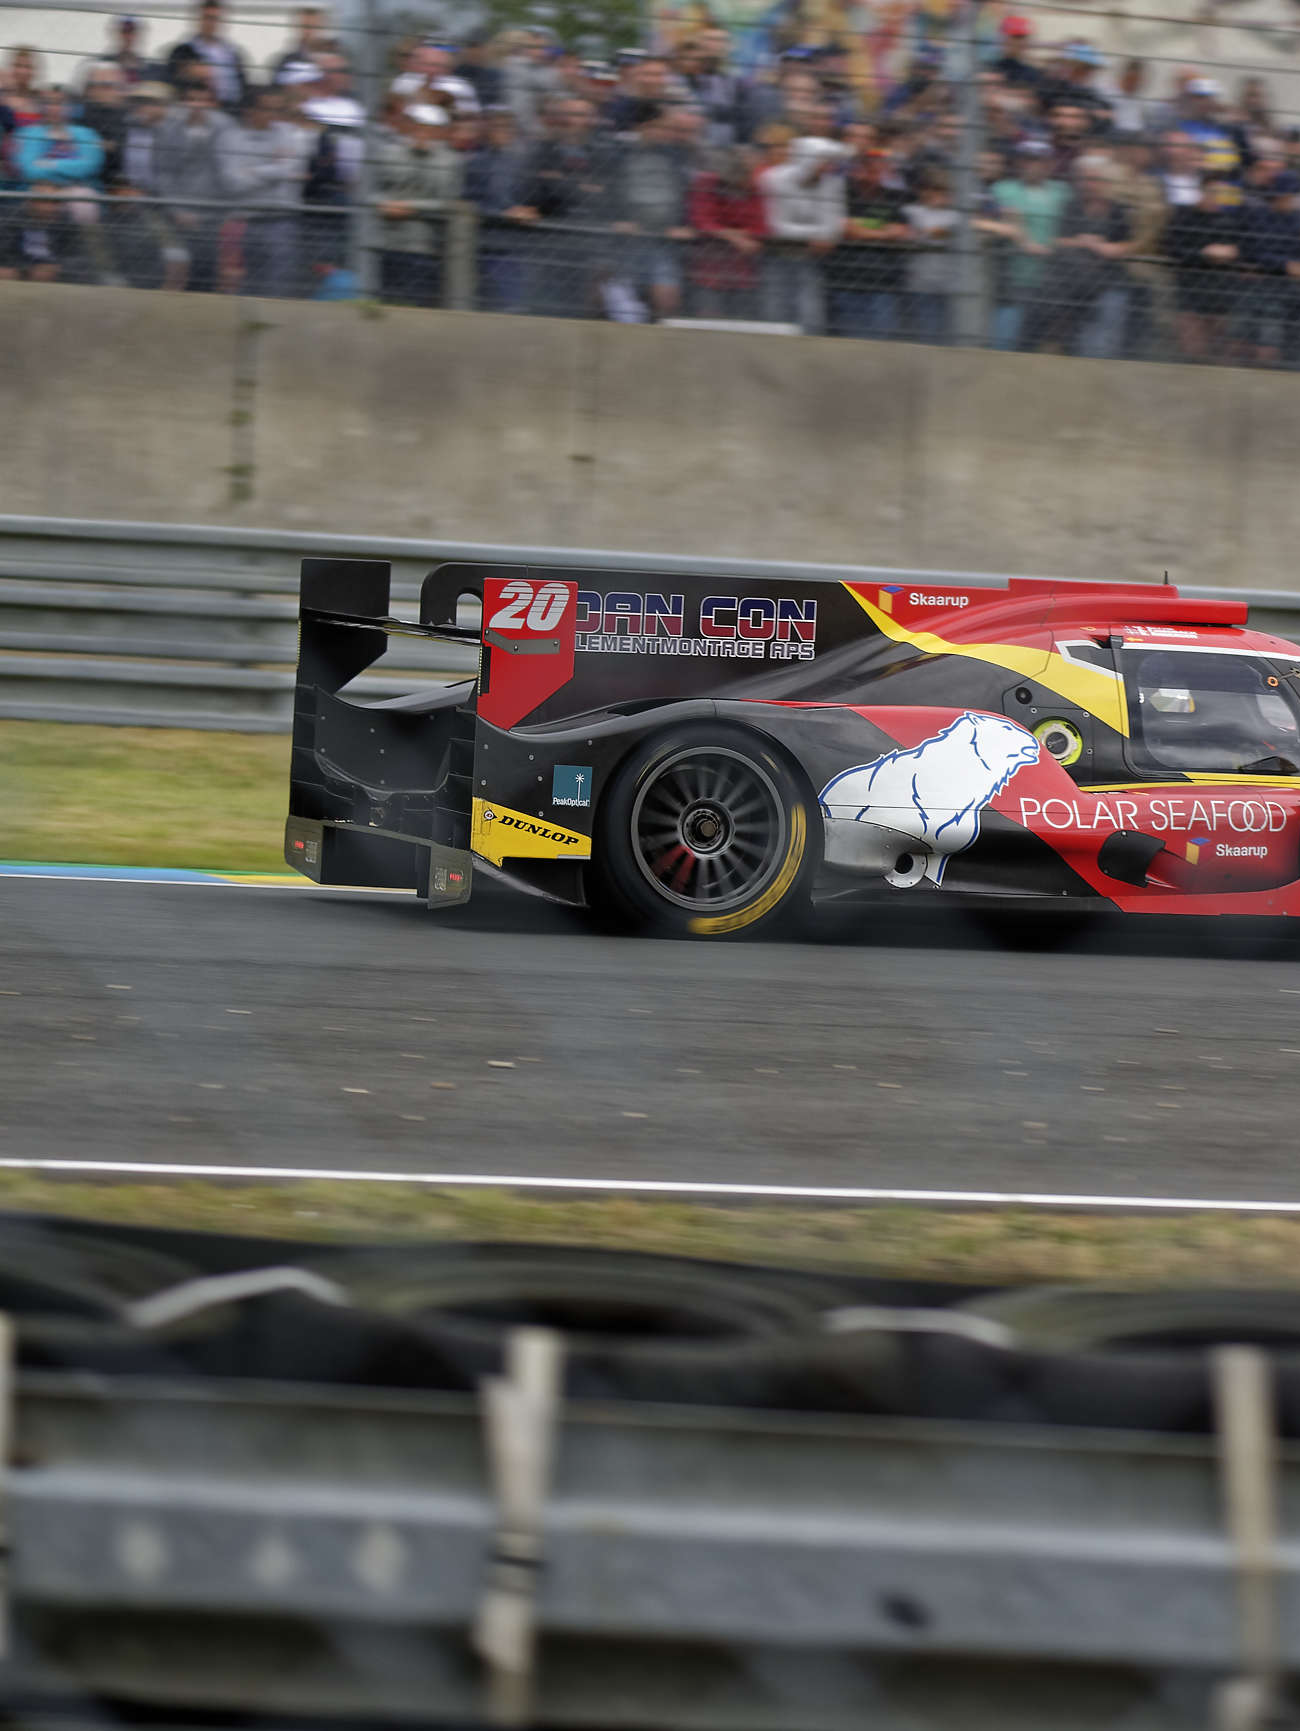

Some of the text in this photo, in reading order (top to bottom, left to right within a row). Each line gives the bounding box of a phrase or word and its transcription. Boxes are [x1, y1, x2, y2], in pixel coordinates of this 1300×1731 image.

[489, 581, 570, 631] 20
[909, 592, 969, 608] Skaarup
[576, 590, 817, 643] DAN CON
[574, 634, 815, 661] LEMENTMONTAGE APS
[498, 815, 580, 845] DUNLOP
[1019, 798, 1288, 832] POLAR SEAFOOD
[1216, 844, 1269, 858] Skaarup
